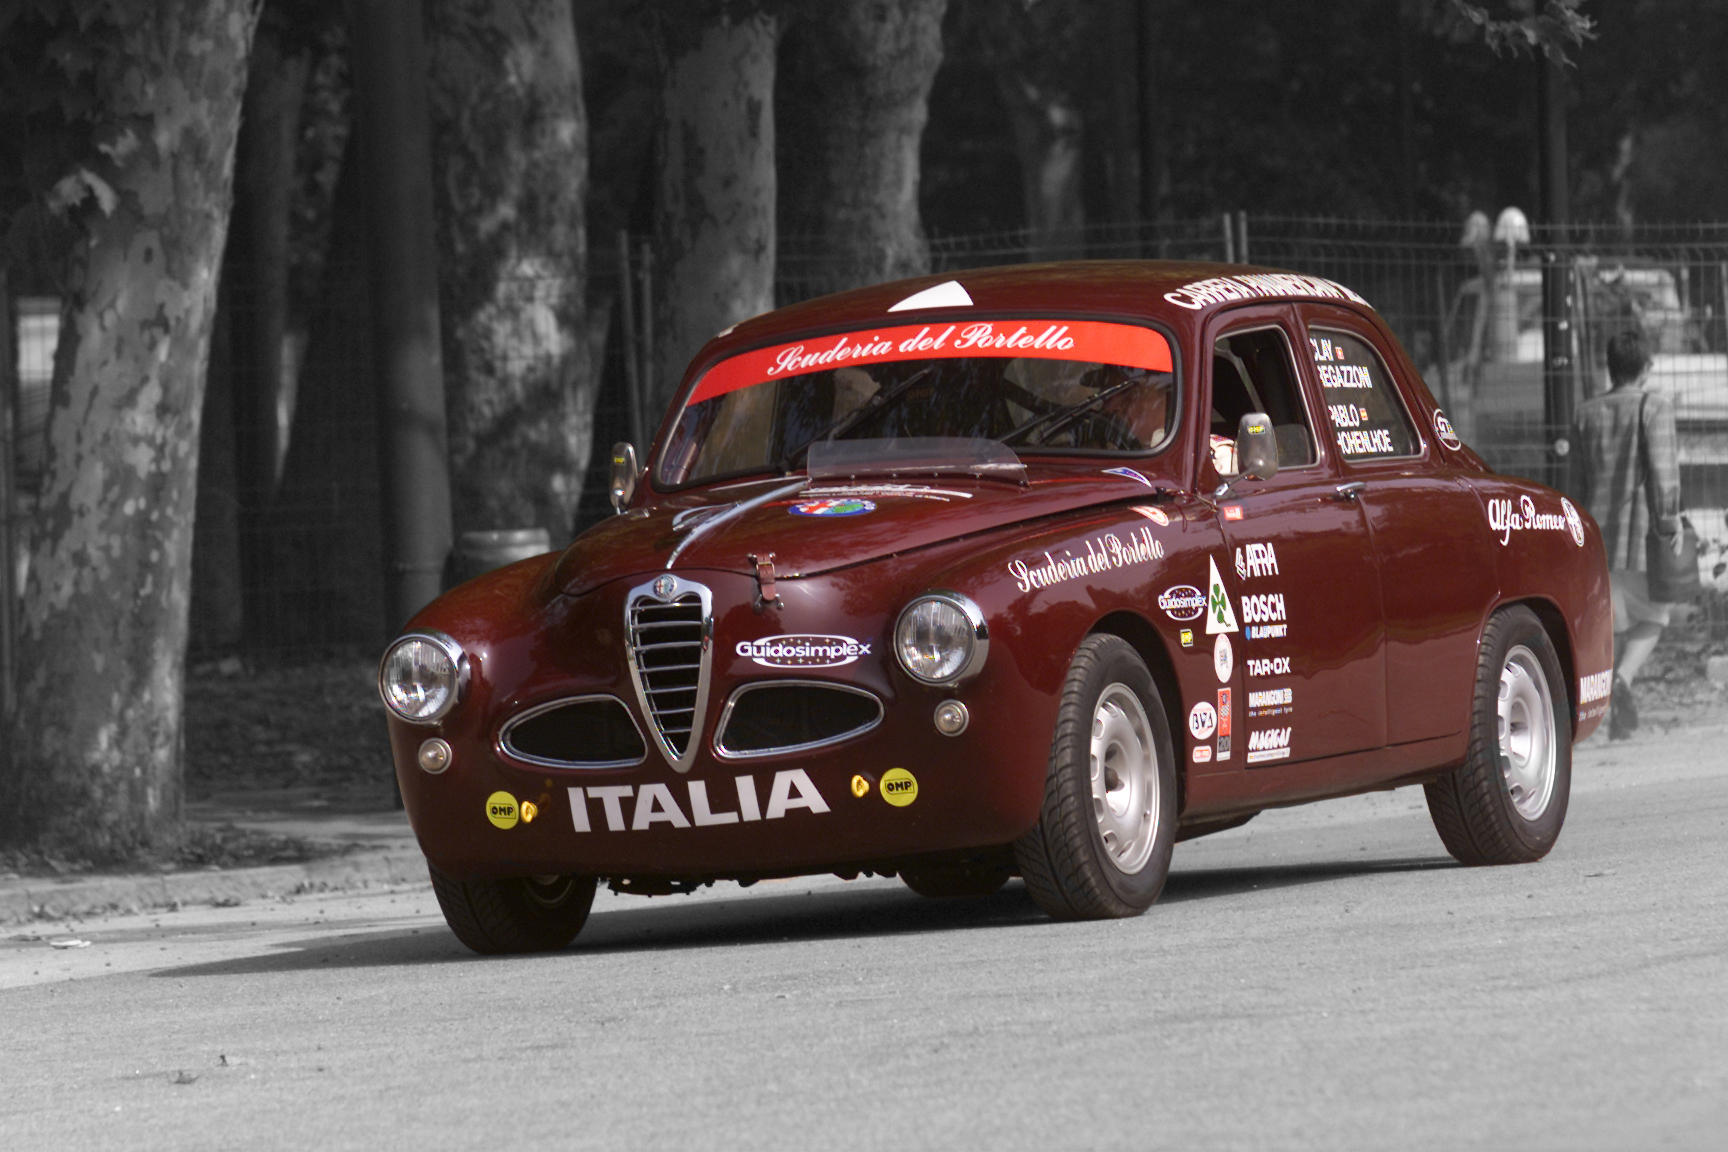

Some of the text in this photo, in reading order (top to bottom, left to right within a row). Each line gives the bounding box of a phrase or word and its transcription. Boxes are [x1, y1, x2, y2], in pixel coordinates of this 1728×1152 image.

[1163, 277, 1256, 310] CARRERA
[767, 322, 1075, 376] Scuderia del Portello
[1520, 494, 1566, 531] Romeo
[1007, 526, 1165, 593] Scuderia del Portello
[1246, 542, 1280, 578] AFRA
[1158, 594, 1208, 610] Guidosimplex
[1240, 593, 1287, 624] BOSCH
[1251, 624, 1288, 639] BLAUPUNKT
[736, 640, 872, 660] Guidosimplex
[567, 768, 831, 833] ITALIA
[885, 779, 913, 793] OMP
[490, 804, 514, 817] OMP
